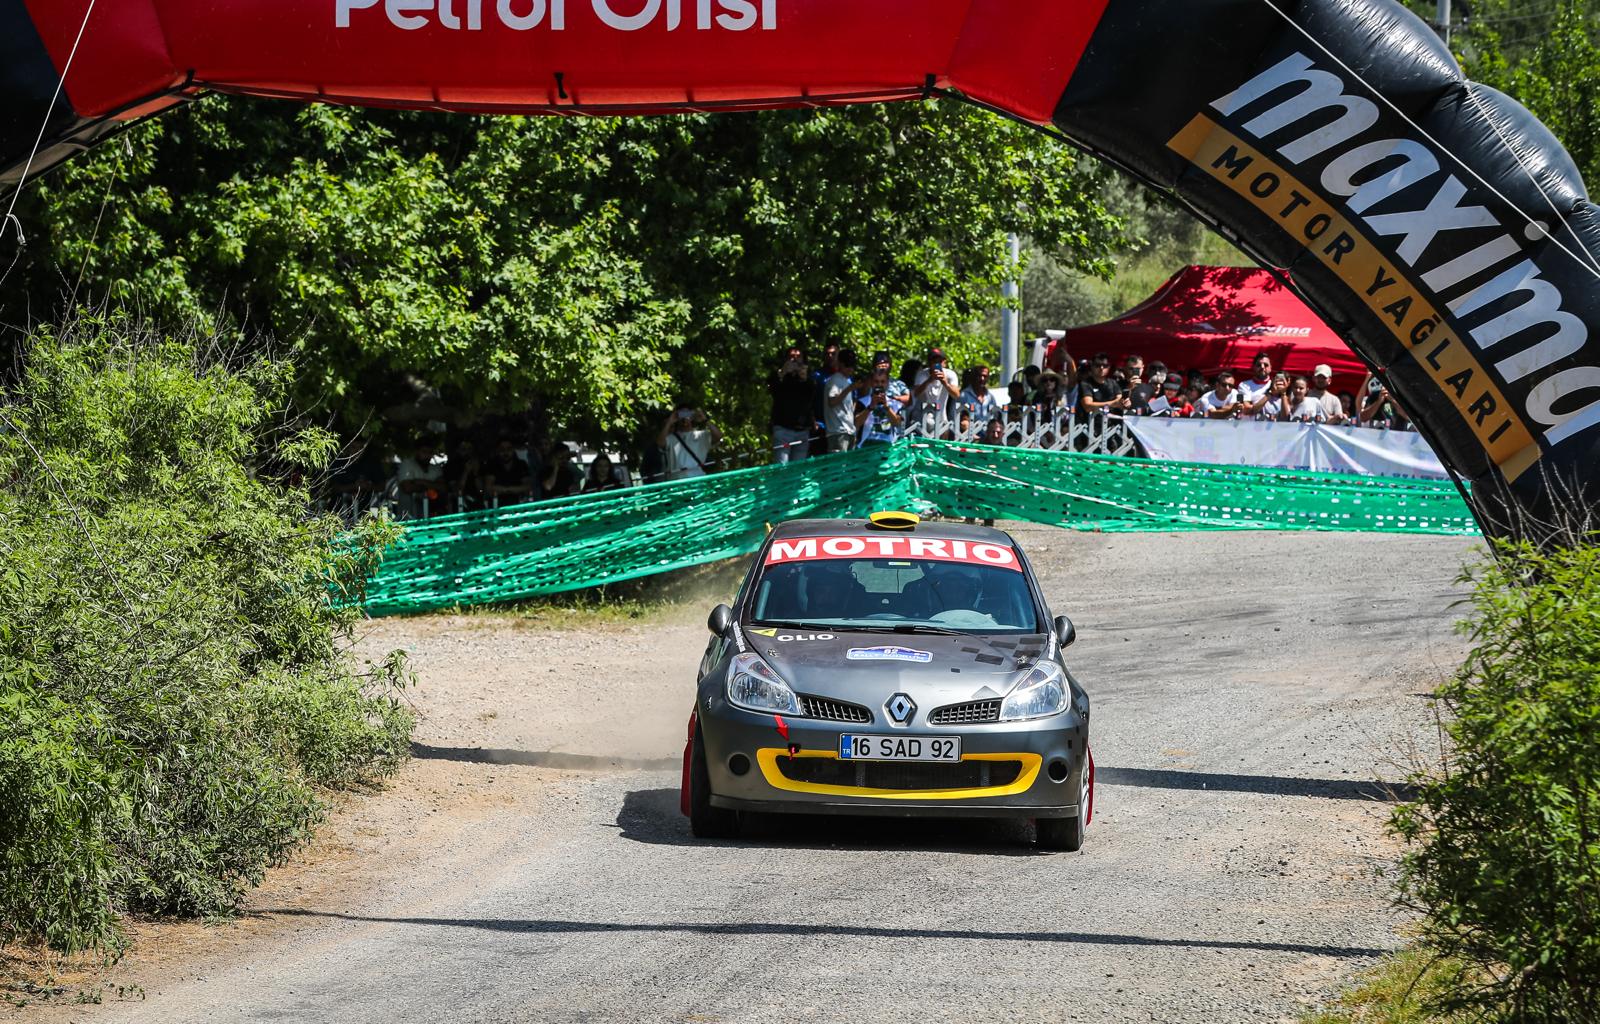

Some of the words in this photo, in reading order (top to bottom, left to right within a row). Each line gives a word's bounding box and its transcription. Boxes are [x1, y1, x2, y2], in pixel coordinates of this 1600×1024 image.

[1209, 51, 1600, 446] maxima
[1211, 145, 1355, 265] MOTOR
[1366, 266, 1513, 444] YAĞLARI
[770, 537, 1014, 564] MOTRIO
[777, 634, 834, 642] CLIO
[852, 737, 871, 756] 16
[880, 739, 922, 757] SAD
[931, 740, 954, 758] 92
